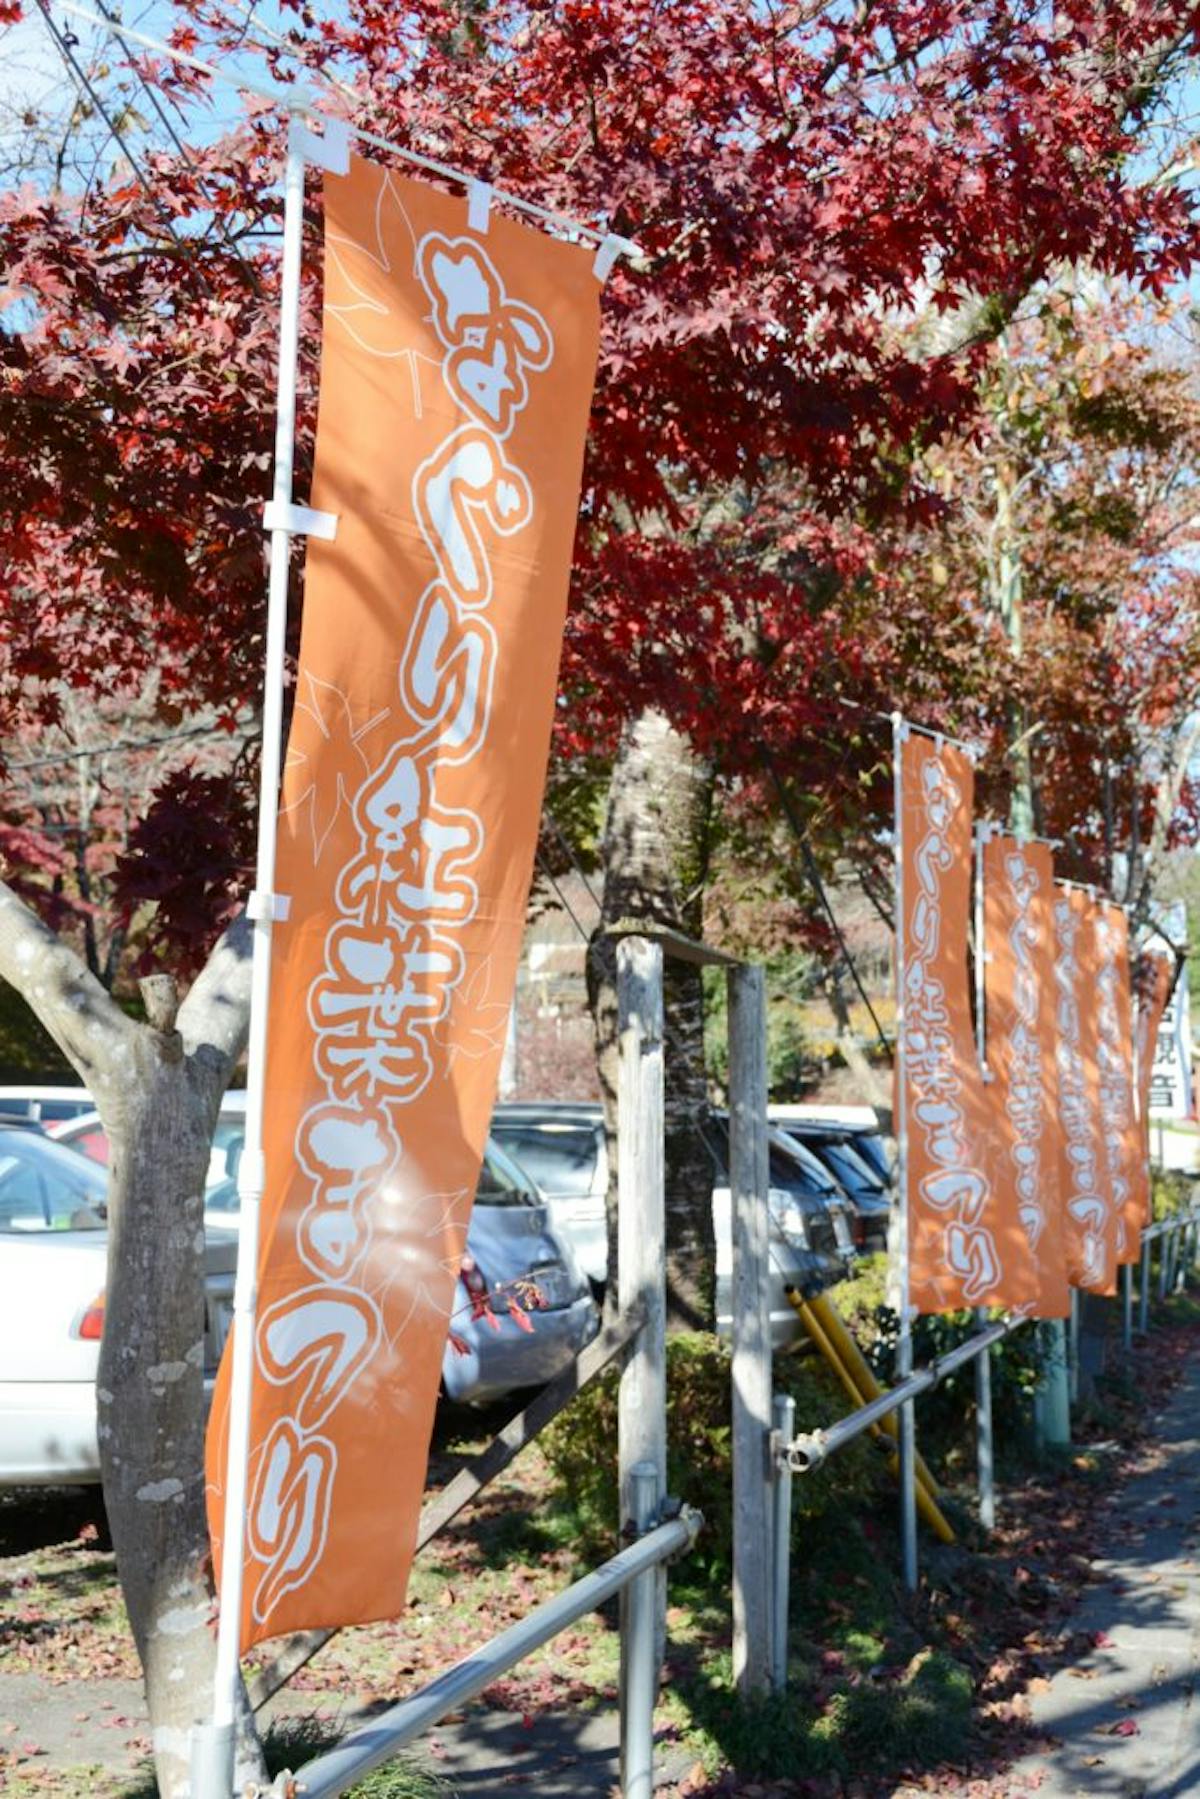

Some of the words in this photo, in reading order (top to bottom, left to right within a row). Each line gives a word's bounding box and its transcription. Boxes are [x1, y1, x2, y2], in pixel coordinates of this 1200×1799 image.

[249, 231, 553, 1625] なぐり紅葉まつり
[904, 757, 1001, 1298] なぐり紅葉まつり
